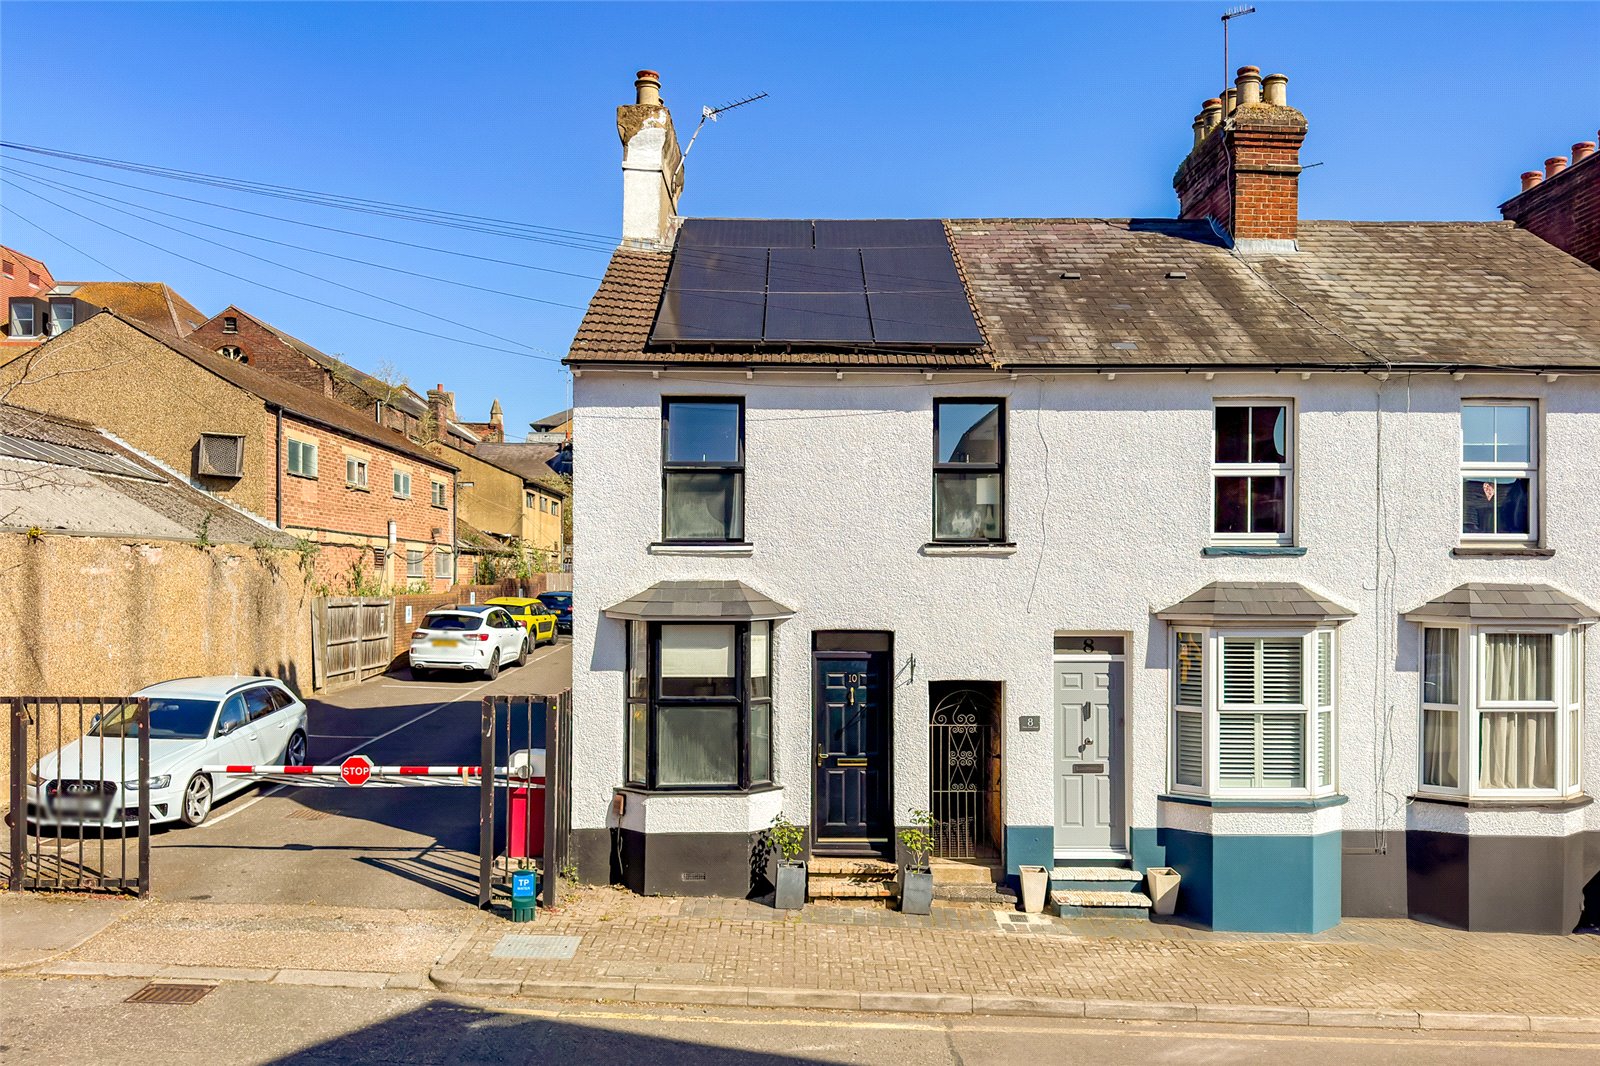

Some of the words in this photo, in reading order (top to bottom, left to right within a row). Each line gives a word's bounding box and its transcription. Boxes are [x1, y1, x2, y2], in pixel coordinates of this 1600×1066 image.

[1083, 638, 1095, 654] 8
[848, 673, 858, 683] 10
[1027, 717, 1034, 726] 8
[343, 766, 369, 776] STOP
